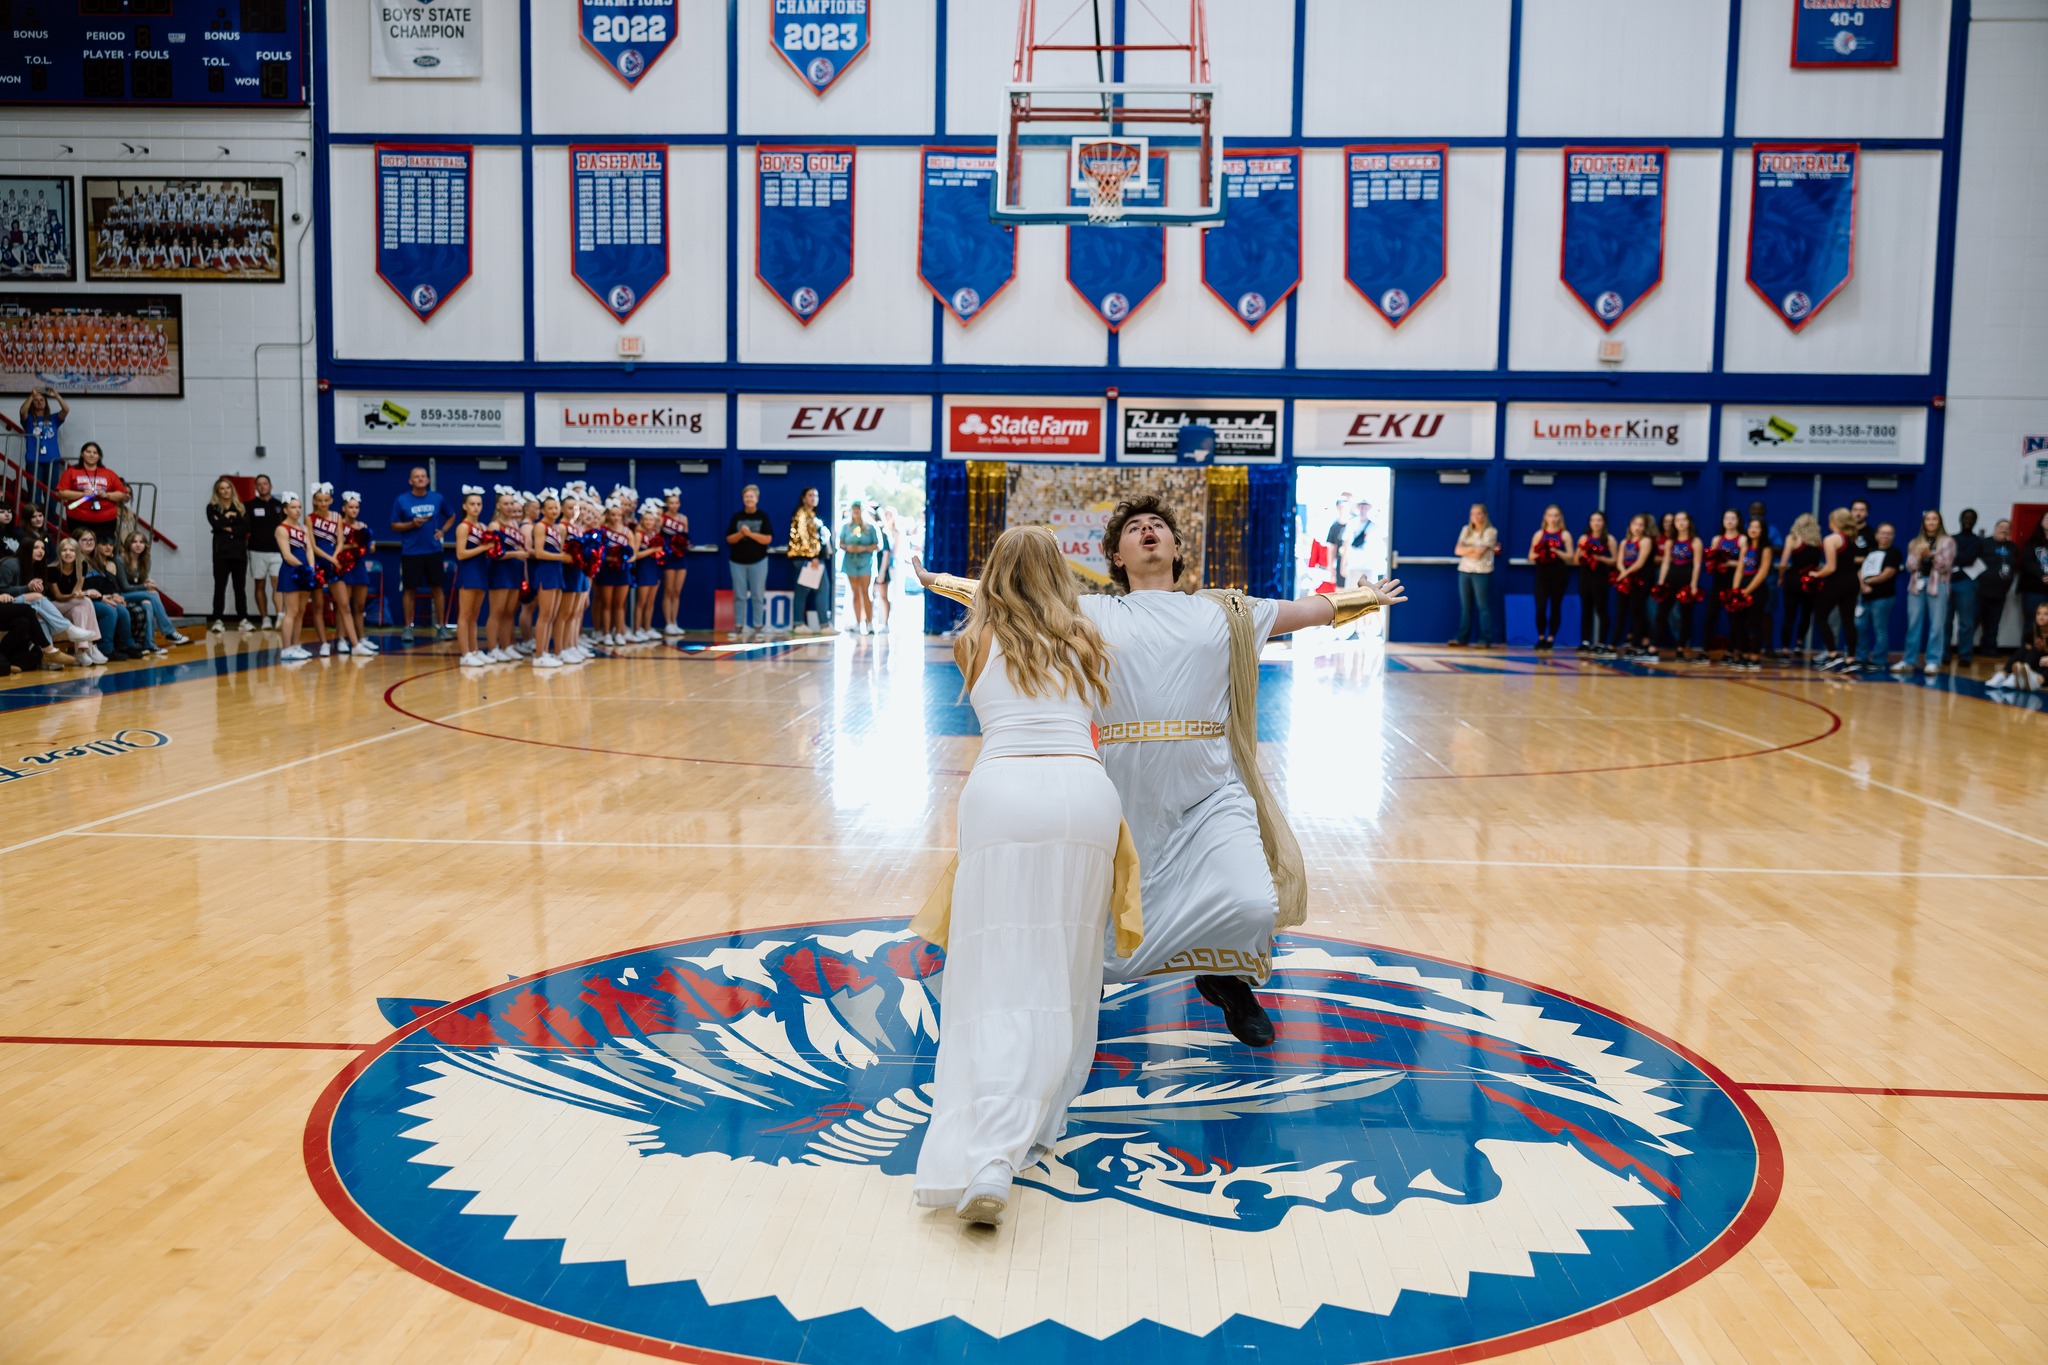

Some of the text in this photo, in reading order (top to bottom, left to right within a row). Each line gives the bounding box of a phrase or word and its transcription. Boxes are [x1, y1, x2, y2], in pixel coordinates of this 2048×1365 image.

[776, 0, 866, 14] CHAMPIONS
[383, 8, 471, 21] BOYS' STATE
[1830, 12, 1864, 26] 40-0
[13, 30, 48, 39] BONUS
[204, 31, 240, 40] BONUS
[390, 25, 464, 38] CHAMPION
[593, 15, 666, 42] 2022
[86, 32, 126, 41] PERIOD
[784, 23, 857, 50] 2023
[25, 56, 52, 65] T.O.L.
[83, 50, 125, 59] PLAYER
[134, 51, 170, 60] FOULS
[202, 57, 230, 66] T.O.L.
[256, 51, 292, 61] FOULS
[0, 76, 21, 84] WON
[234, 78, 260, 86] WON
[407, 156, 467, 169] BASKETBALL
[576, 153, 661, 171] BASEBALL
[760, 154, 853, 173] BOYS GOLF
[1221, 159, 1292, 175] OYS TRACK
[1351, 155, 1441, 171] BOYS SOCCER
[1570, 154, 1660, 174] FOOTBALL
[1759, 153, 1850, 172] FOOTBALL
[420, 409, 502, 421] 859-358-7800
[564, 407, 702, 433] LumberKing
[791, 407, 885, 431] EKU
[1126, 410, 1274, 430] Richmond
[1347, 414, 1445, 437] EKU
[1533, 418, 1679, 445] LumberKing
[1809, 424, 1897, 438] 859-358-7800
[1062, 541, 1090, 555] LAS
